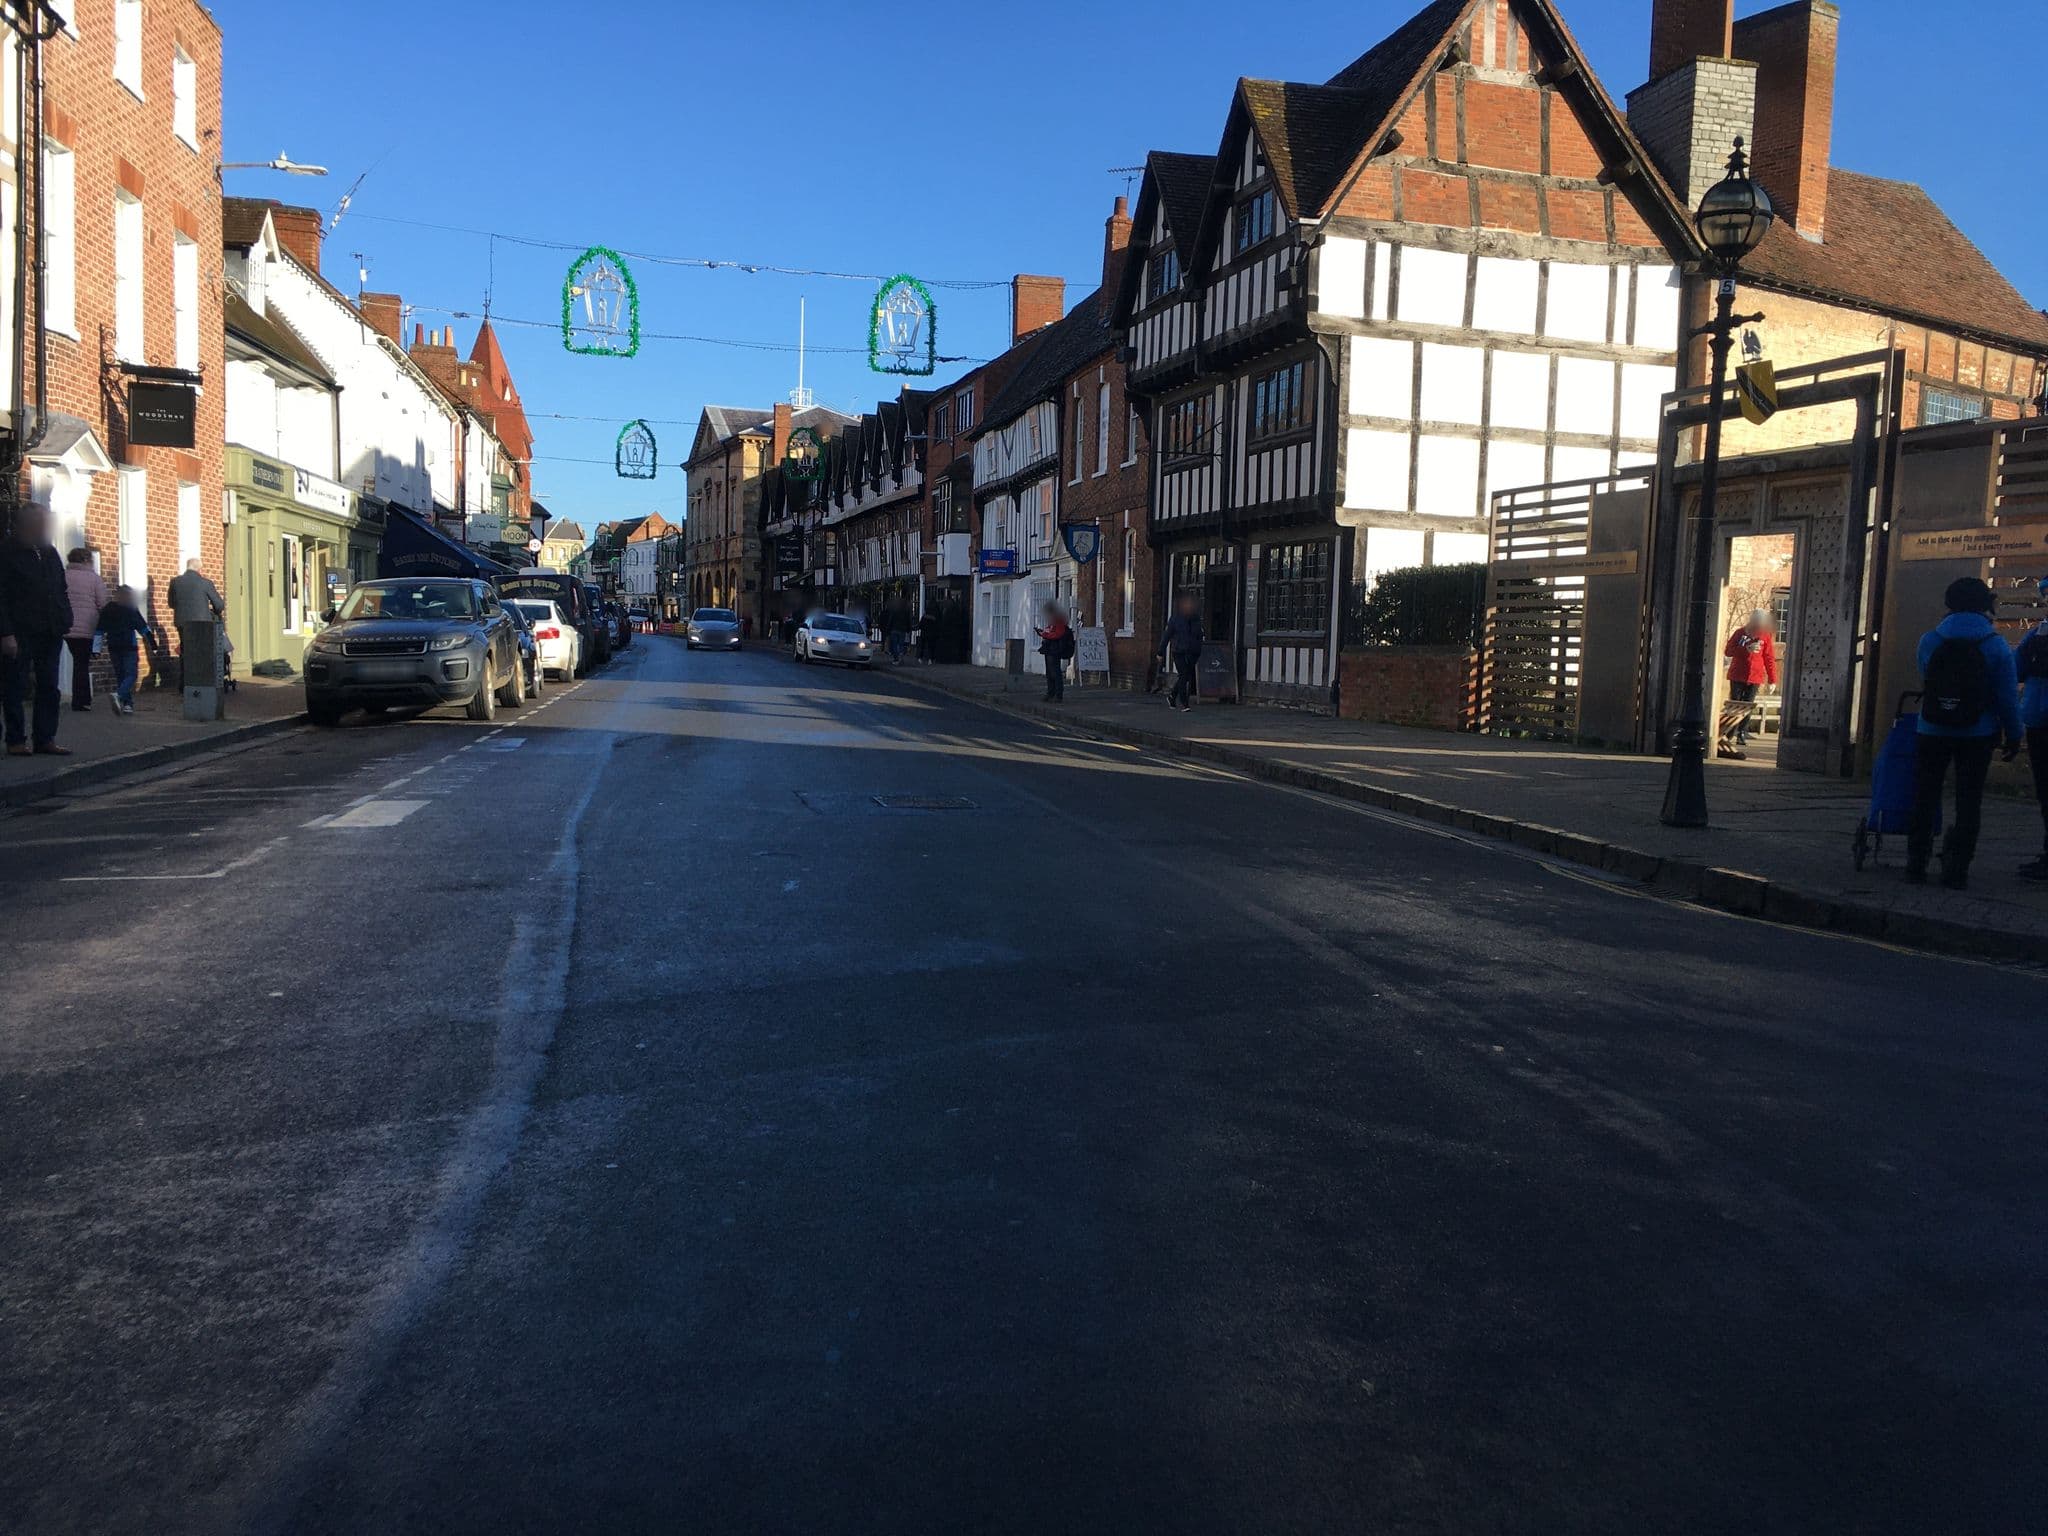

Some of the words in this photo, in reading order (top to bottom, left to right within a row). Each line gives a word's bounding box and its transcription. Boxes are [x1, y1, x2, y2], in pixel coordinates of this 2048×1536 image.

[1722, 280, 1732, 292] 5
[502, 531, 527, 541] MOON
[1080, 639, 1106, 648] BOOKS
